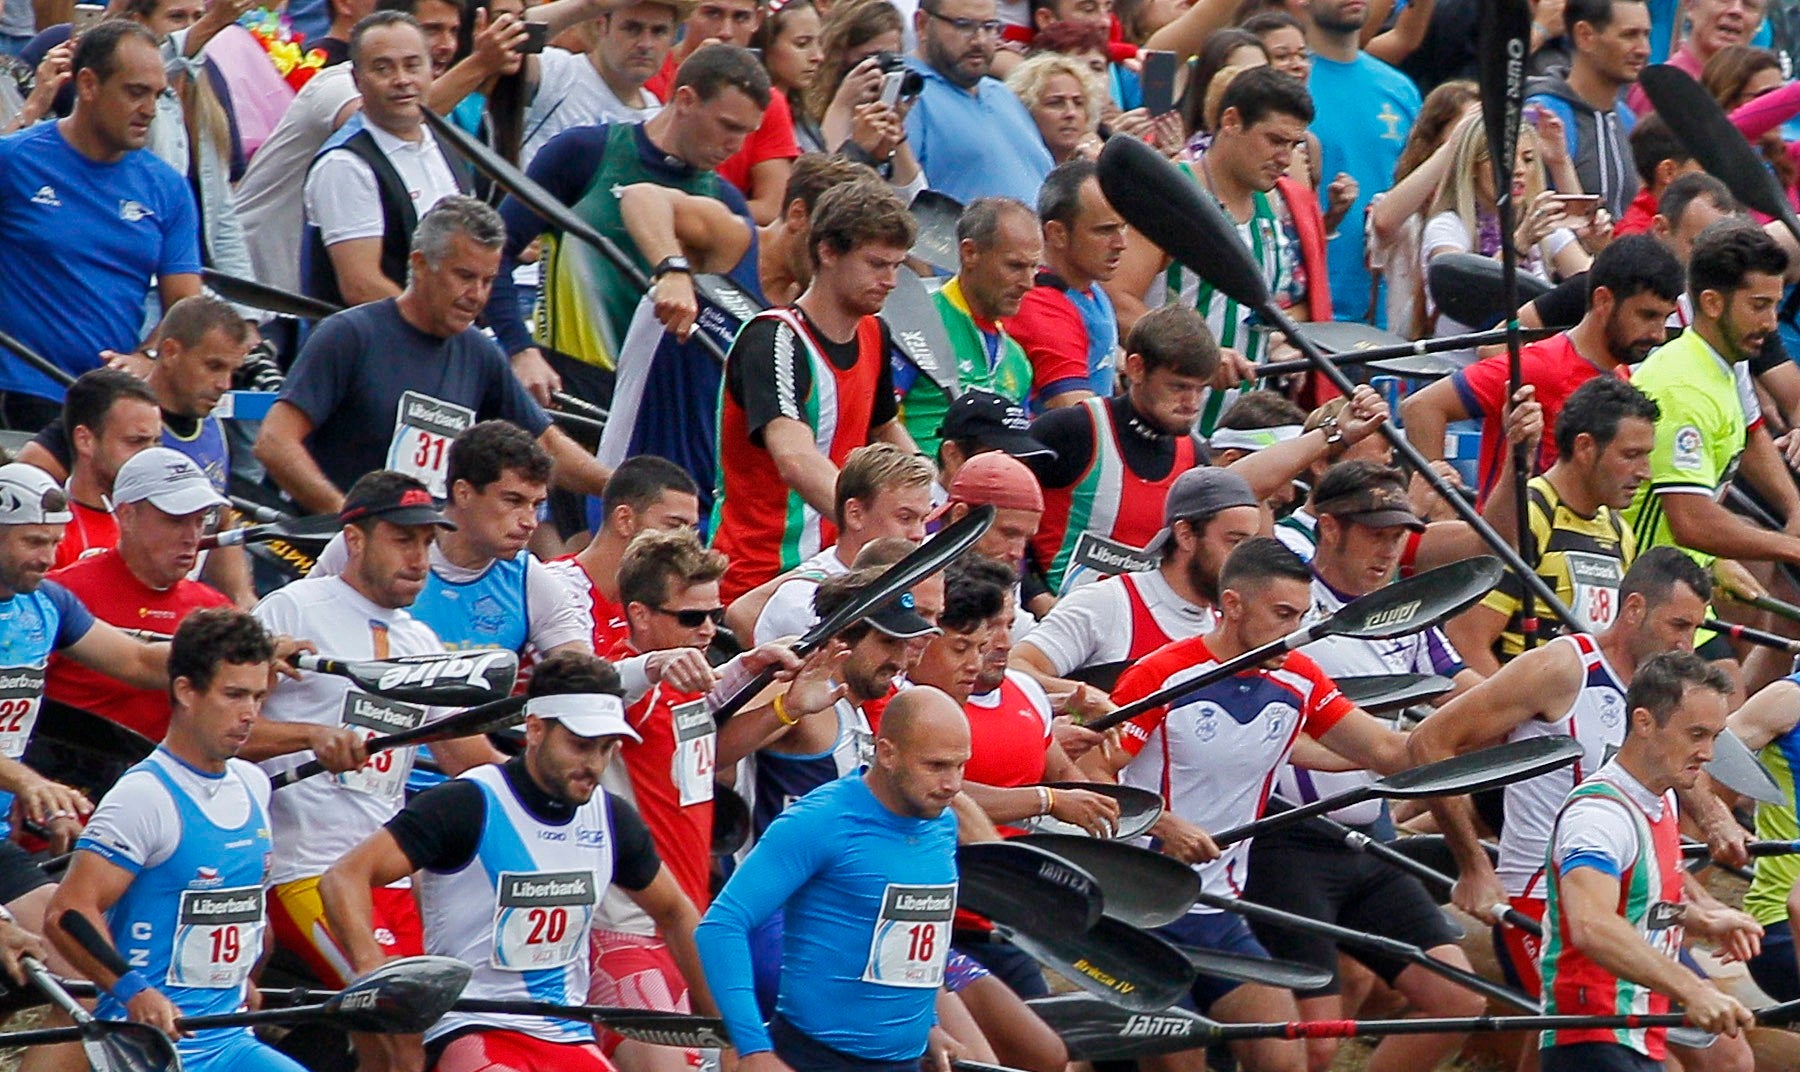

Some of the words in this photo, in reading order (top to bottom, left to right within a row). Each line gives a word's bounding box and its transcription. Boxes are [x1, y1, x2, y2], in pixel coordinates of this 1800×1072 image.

[414, 431, 446, 472] 31
[378, 651, 502, 692] Jaire
[353, 698, 417, 730] Liberbank
[191, 895, 259, 916] Liberbank
[510, 877, 586, 900] Liberbank
[894, 894, 953, 912] Liberbank
[208, 925, 242, 965] 19
[527, 907, 568, 946] 20
[907, 922, 937, 963] 18
